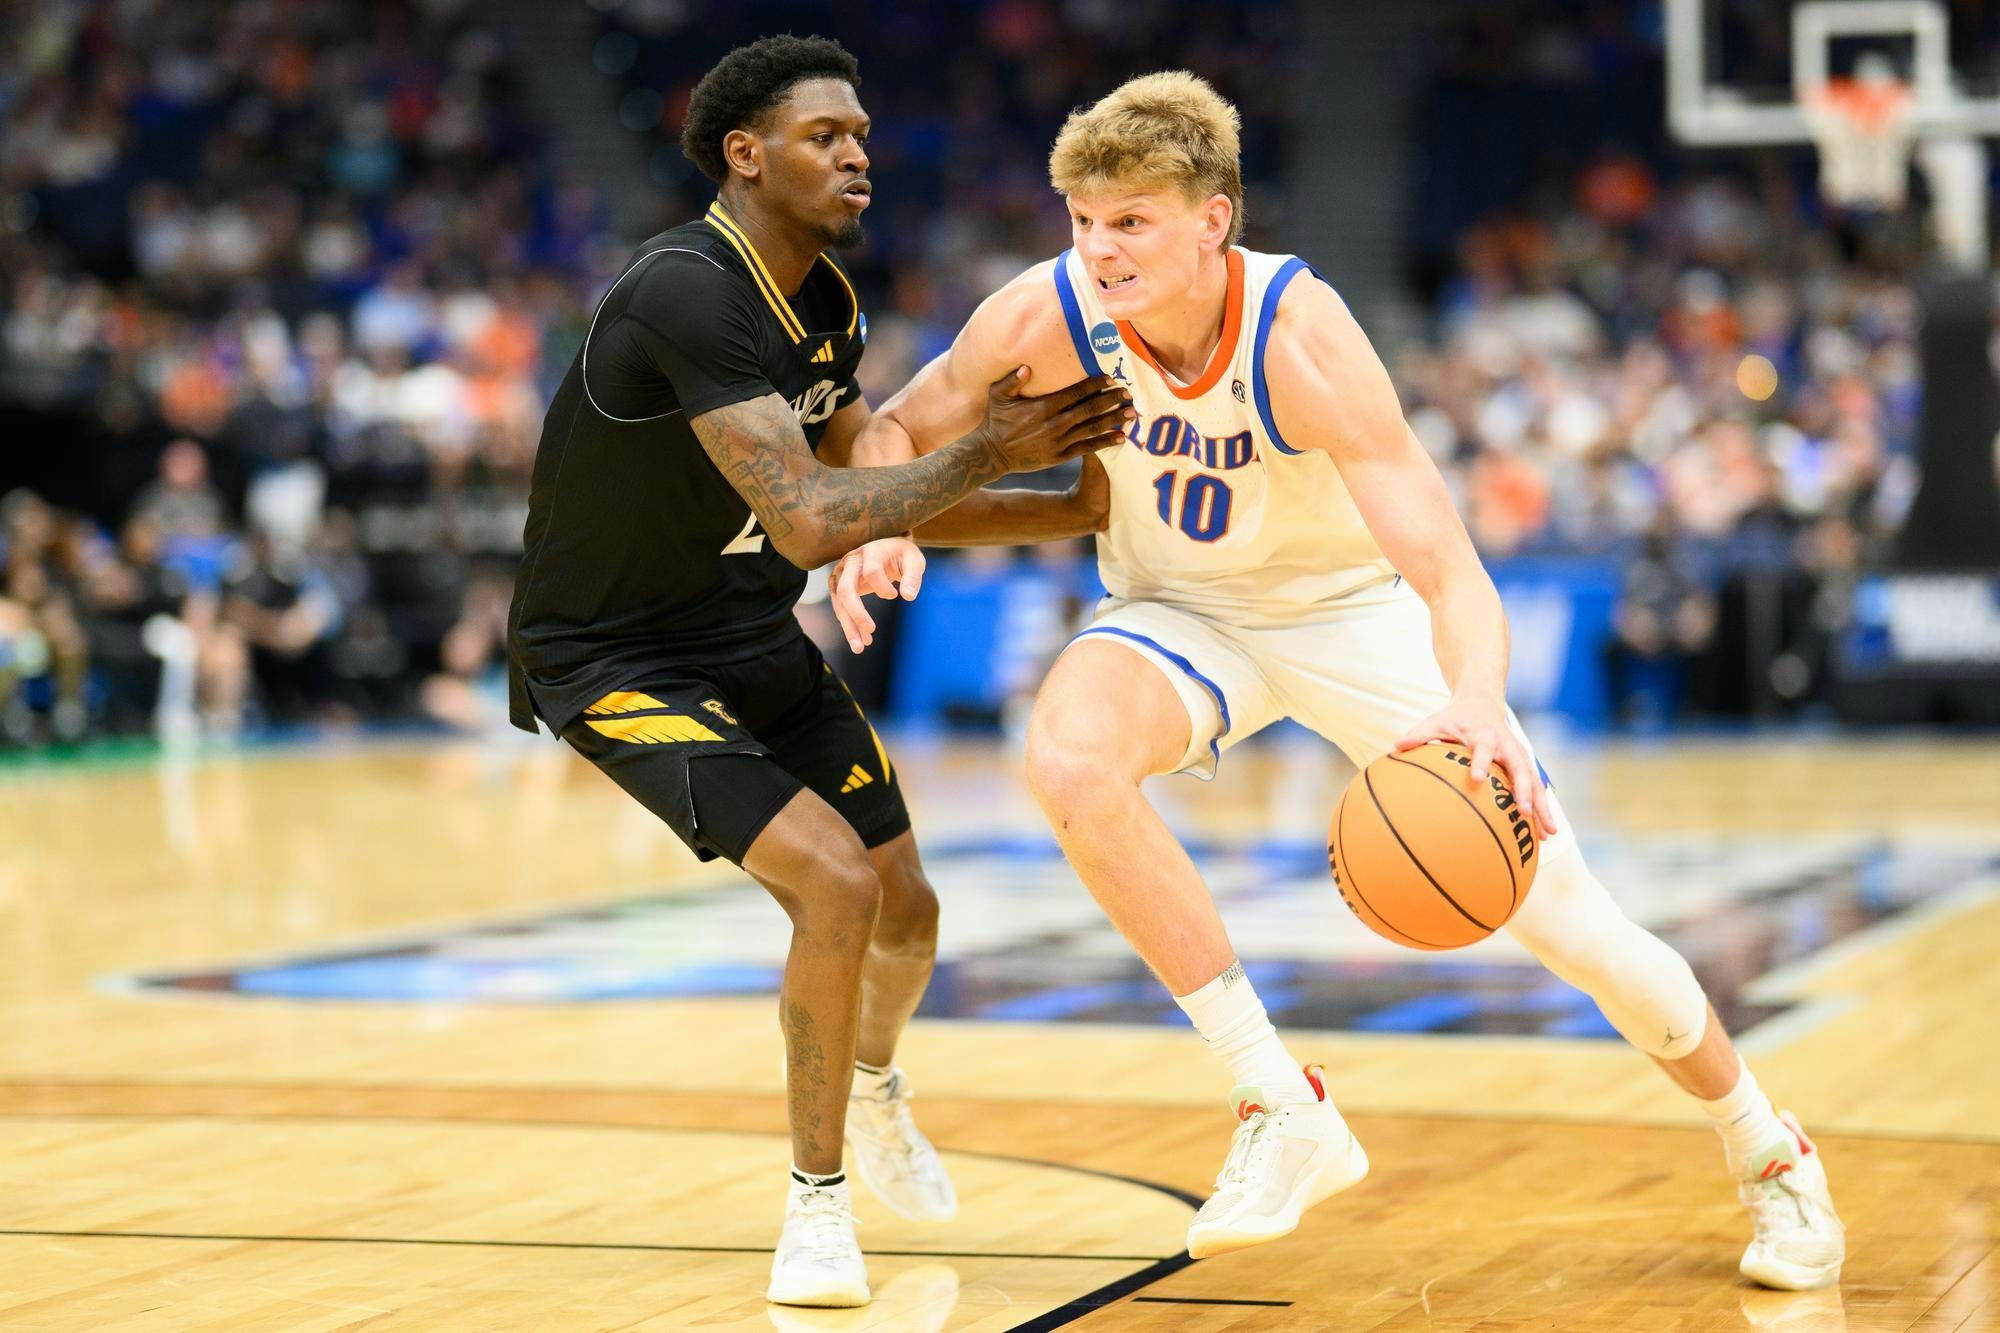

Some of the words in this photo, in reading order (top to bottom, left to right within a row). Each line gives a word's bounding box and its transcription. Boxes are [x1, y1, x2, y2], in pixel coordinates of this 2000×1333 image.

[1094, 335, 1121, 348] NCAA
[1112, 401, 1262, 470] LORID
[1153, 469, 1233, 544] 10
